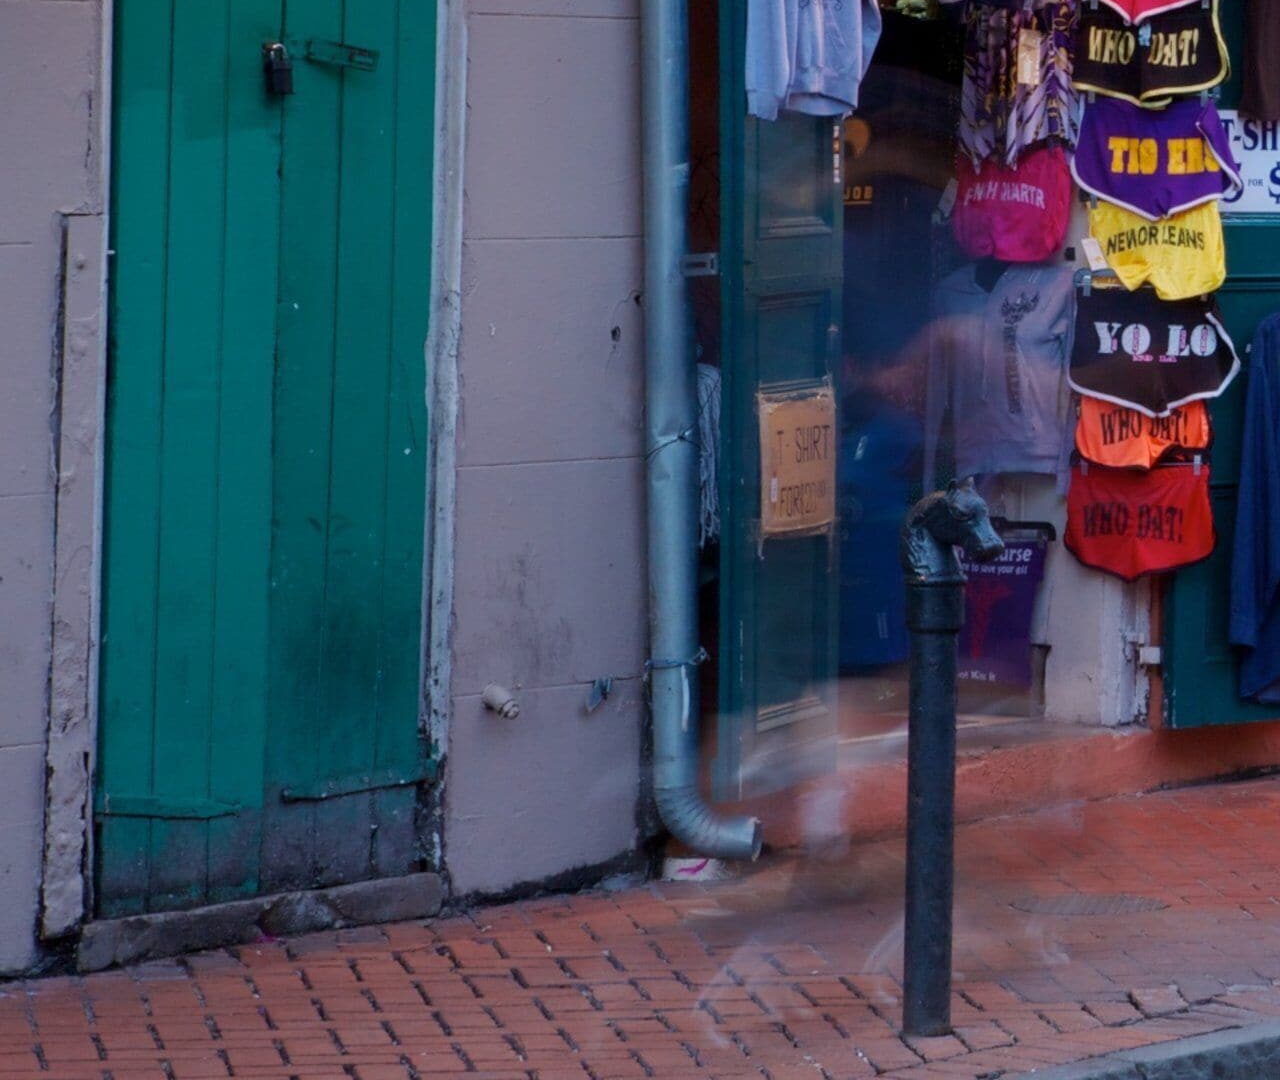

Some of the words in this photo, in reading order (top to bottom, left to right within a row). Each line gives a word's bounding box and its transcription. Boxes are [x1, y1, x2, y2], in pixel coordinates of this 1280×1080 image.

[1088, 26, 1135, 64] WHO
[1148, 28, 1199, 67] DAT!
[1247, 178, 1264, 187] FOR
[1100, 411, 1143, 446] WHO
[1081, 503, 1131, 539] WHO
[1137, 504, 1185, 544] DAT!
